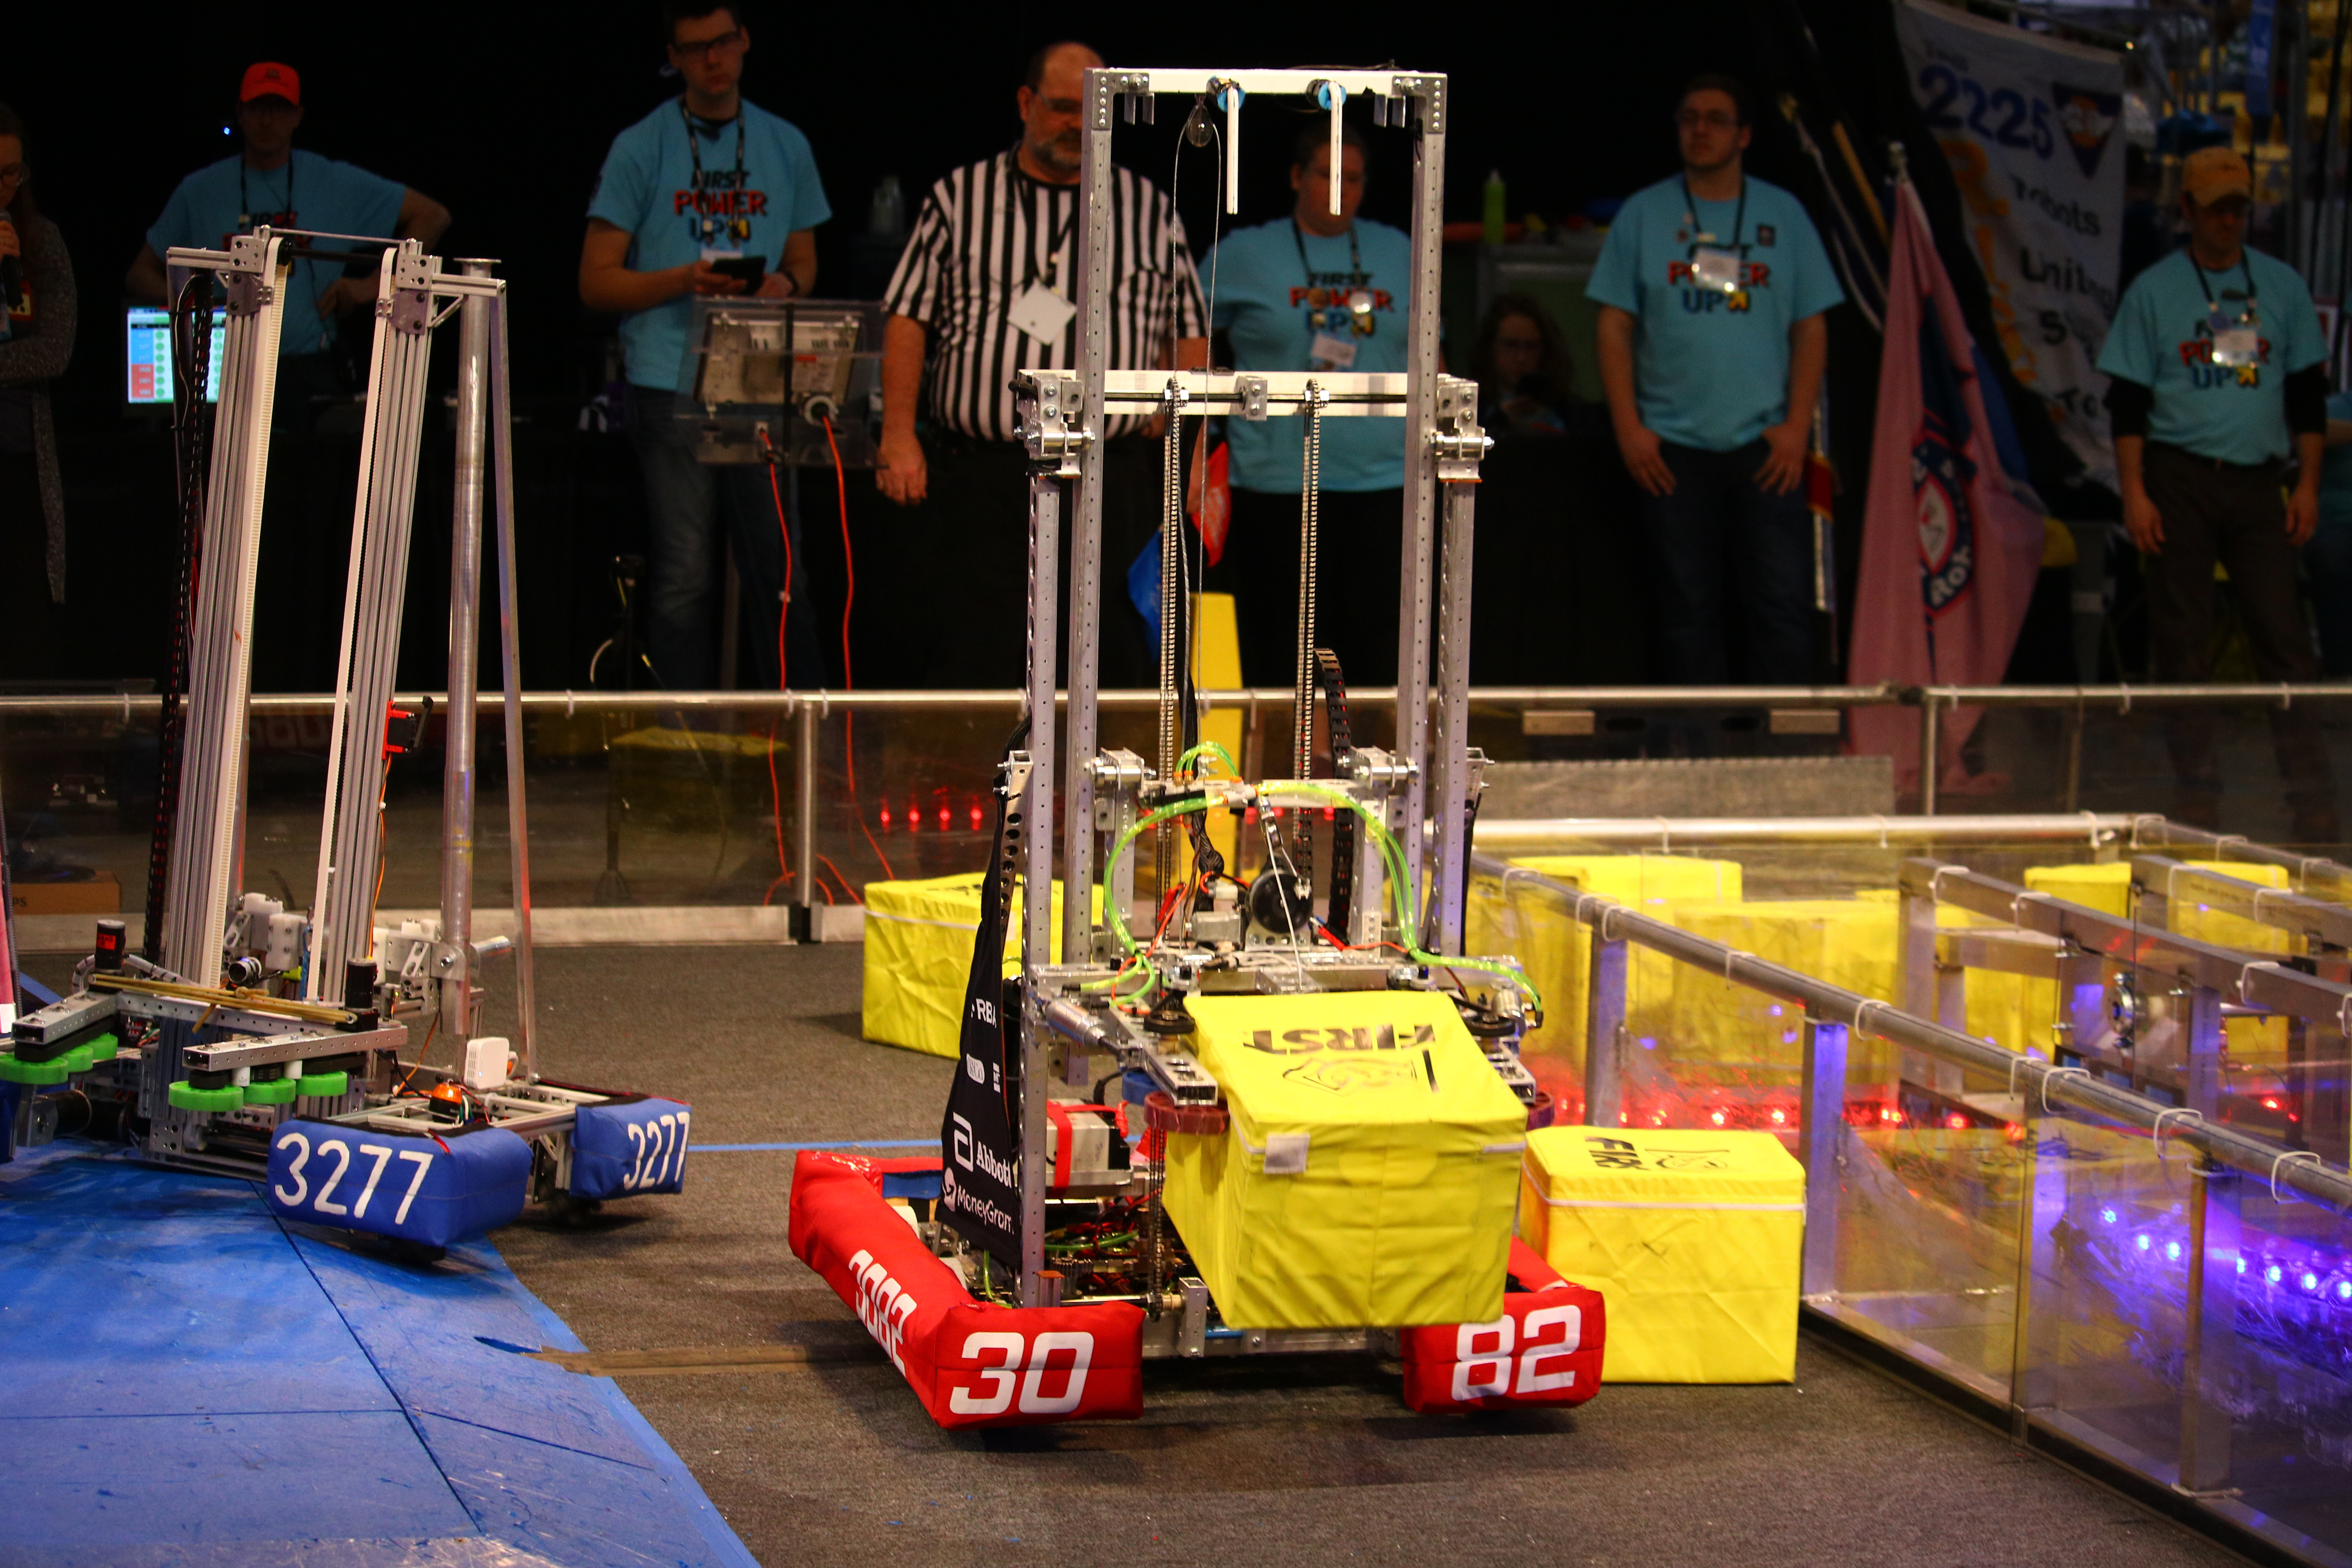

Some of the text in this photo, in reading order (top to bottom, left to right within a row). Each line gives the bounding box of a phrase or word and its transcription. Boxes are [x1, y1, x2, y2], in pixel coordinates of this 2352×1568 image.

[1920, 65, 2053, 160] 2225
[674, 189, 766, 216] POWER
[1290, 286, 1394, 312] PWR
[1682, 289, 1724, 312] UP
[2193, 366, 2234, 388] UP
[275, 1132, 434, 1225] 3277
[624, 1111, 690, 1191] 3277
[976, 1140, 1012, 1189] Abbott
[848, 1249, 917, 1379] 3082
[1452, 1305, 1581, 1401] 82
[949, 1332, 1094, 1414] 30
